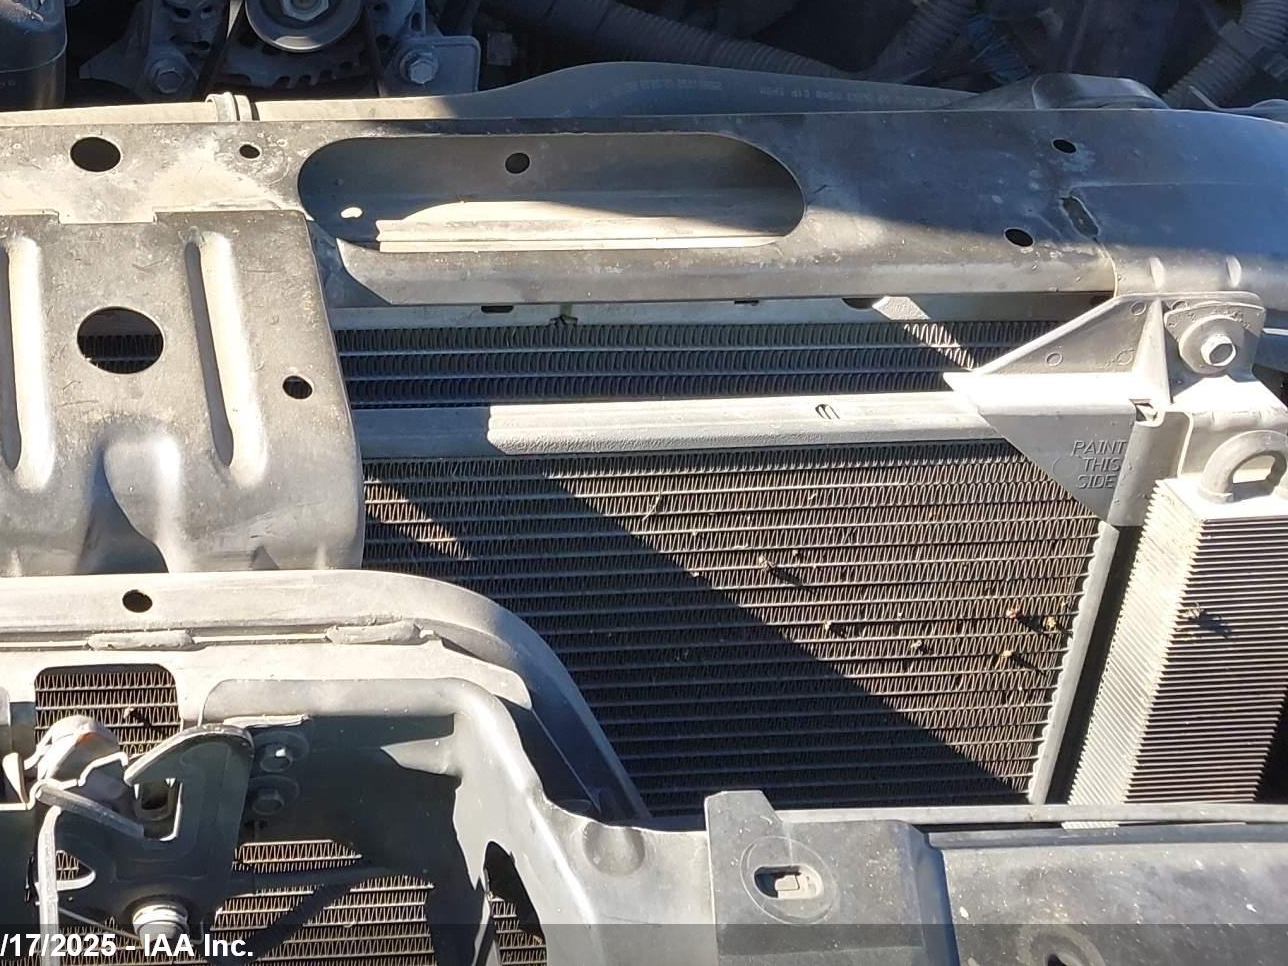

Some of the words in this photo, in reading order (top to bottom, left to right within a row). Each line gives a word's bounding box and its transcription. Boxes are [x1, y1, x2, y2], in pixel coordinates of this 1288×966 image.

[1070, 439, 1128, 456] PAINT
[1082, 457, 1122, 472] THIS
[1077, 474, 1117, 490] SIDE
